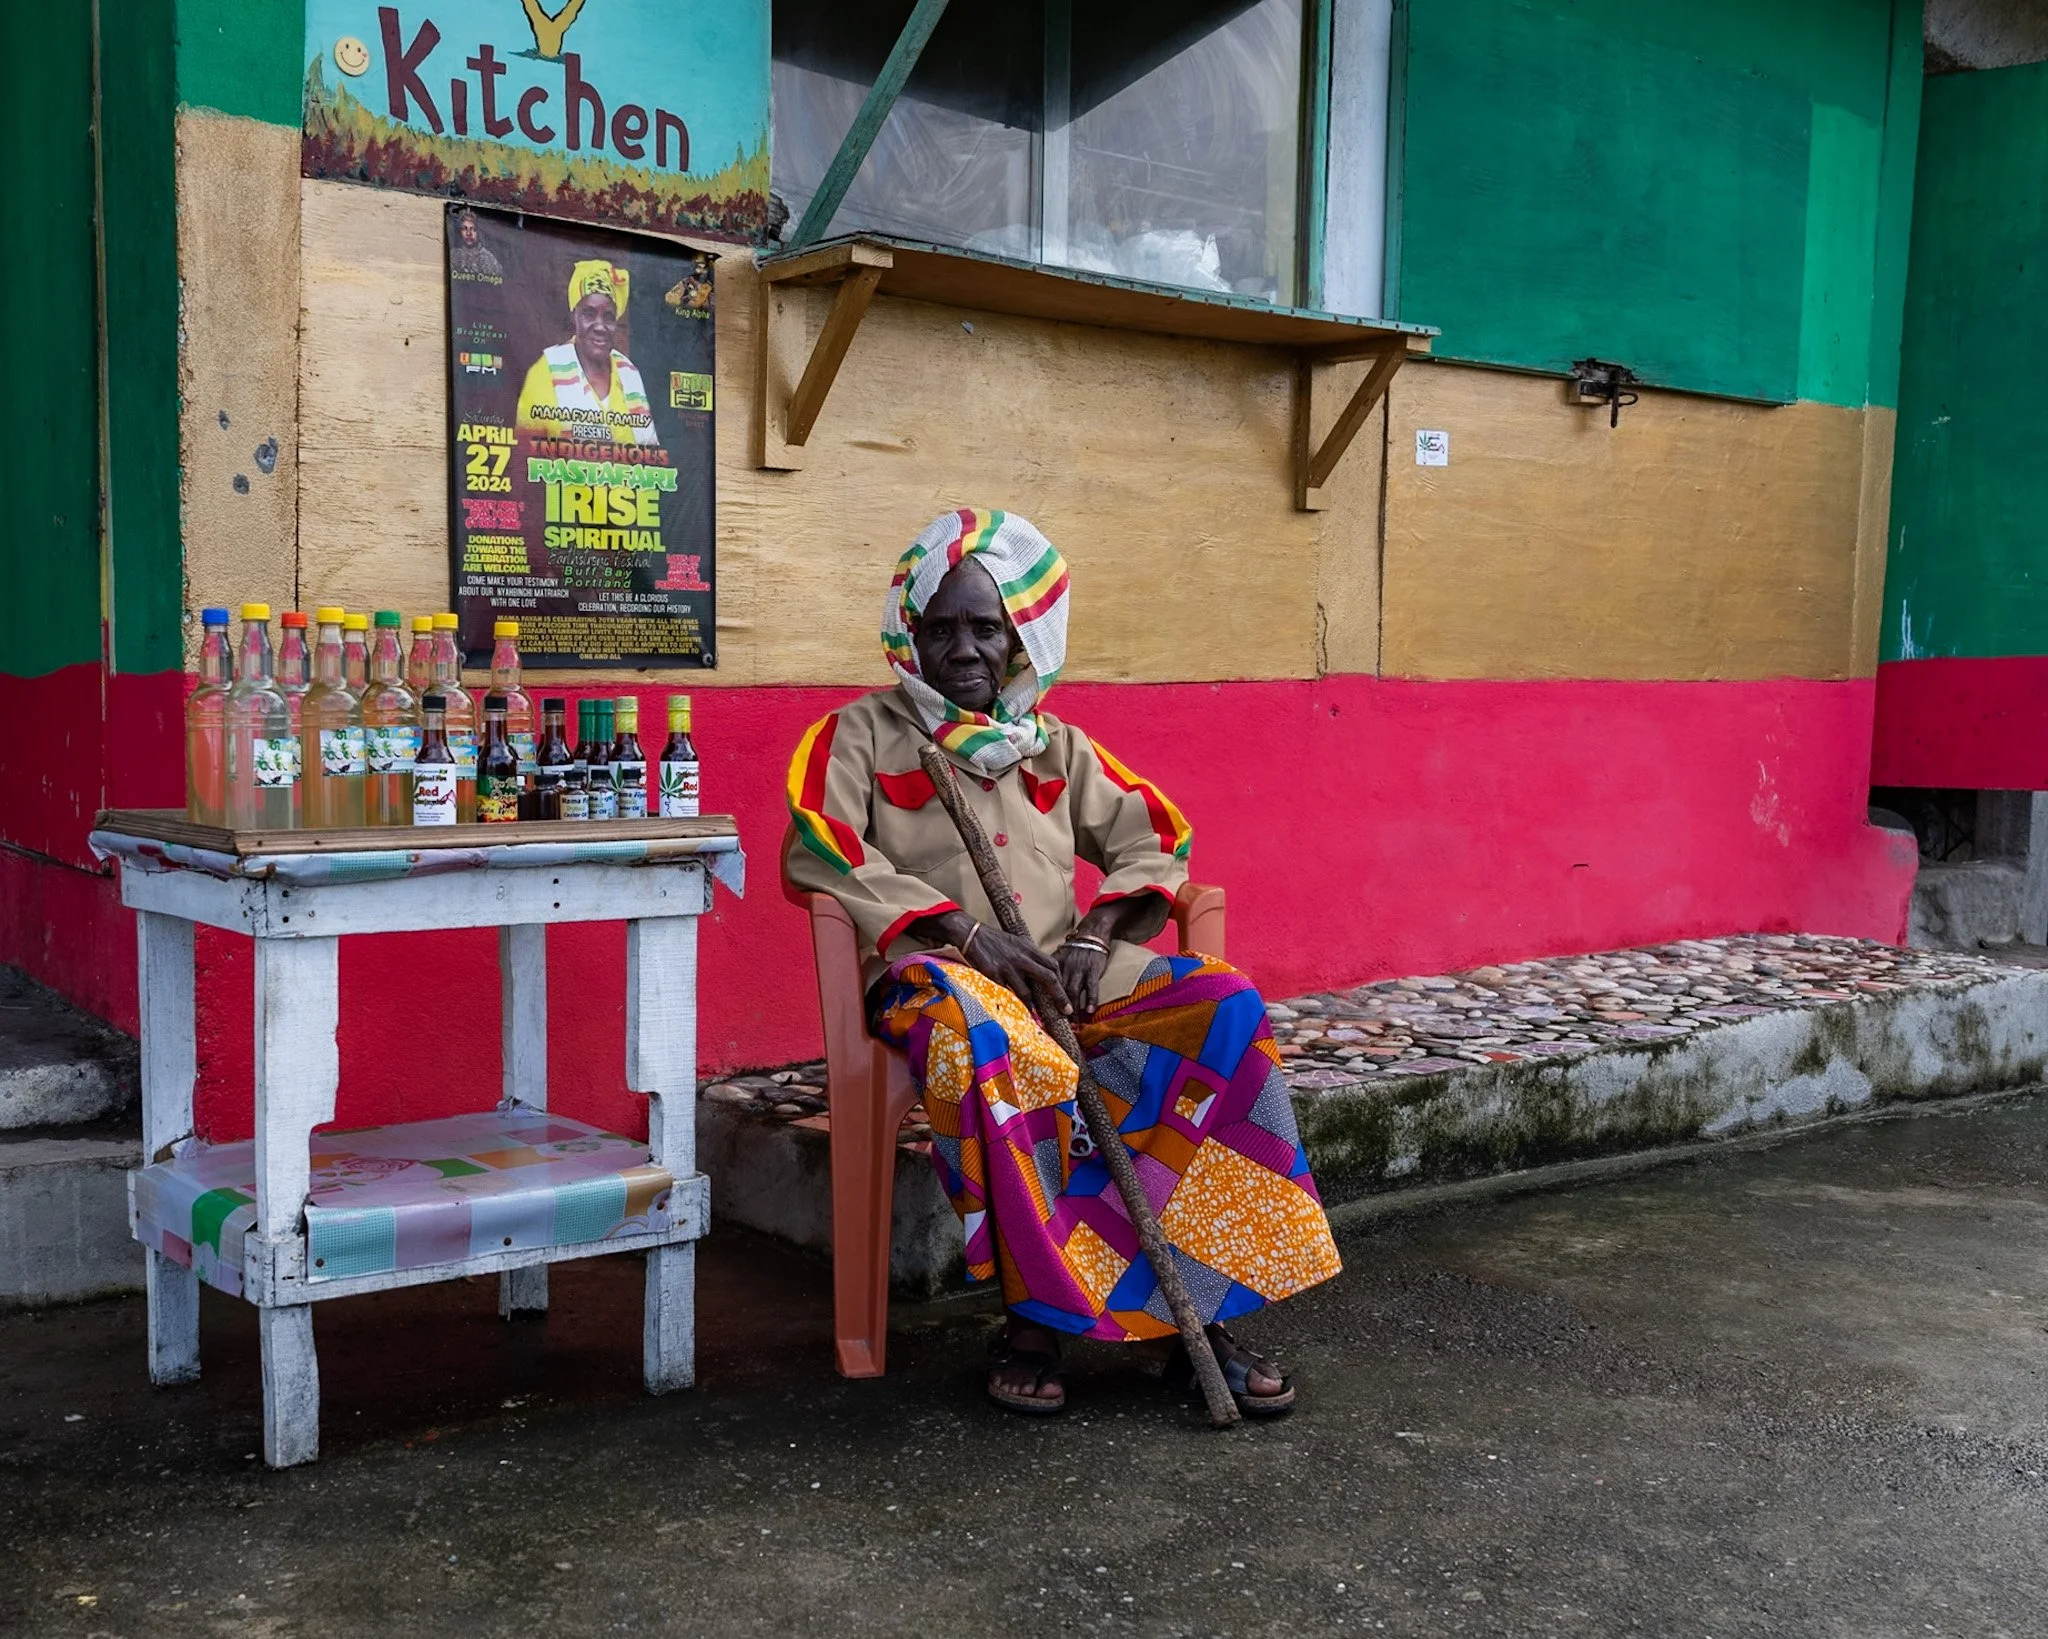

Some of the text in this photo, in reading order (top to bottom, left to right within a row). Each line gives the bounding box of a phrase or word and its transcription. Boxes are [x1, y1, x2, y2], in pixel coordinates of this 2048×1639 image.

[378, 6, 690, 172] Kitchen
[451, 270, 503, 286] Queen Omega
[675, 307, 711, 319] King Alpha
[473, 321, 494, 330] Live
[456, 327, 507, 339] Broadcast
[473, 336, 486, 345] On
[674, 391, 707, 408] FM
[531, 405, 652, 428] MAMA FYAH FAMILY
[456, 423, 519, 446] APRIL
[572, 424, 612, 440] PRESENTS
[528, 437, 670, 466] INDIGENOUS
[465, 443, 511, 477] 27
[526, 457, 678, 492] RASTAFARI
[466, 474, 513, 493] 2024
[545, 483, 661, 528] IRISE
[467, 534, 526, 546] DONATIONS
[543, 525, 667, 552] SPIRITUAL
[465, 544, 528, 555] TOWARD THE
[463, 553, 528, 564] CELEBRATION
[462, 562, 532, 574] ARE WELCOME
[564, 565, 633, 580] Buff Bay
[466, 575, 559, 588] COME MAKE YOUR TESTIMONY
[564, 576, 633, 589] Portland
[458, 586, 480, 596] ABOUT
[480, 586, 494, 597] OUR
[534, 588, 570, 599] MATRIARCH
[598, 592, 669, 604] LET THIS BE A GLORIOUS
[490, 597, 538, 608] WITH ONE LOVE
[619, 603, 653, 613] RECORDING
[653, 603, 666, 613] OUR
[666, 604, 692, 614] HISTORY
[419, 785, 439, 797] Red
[683, 781, 698, 791] Red
